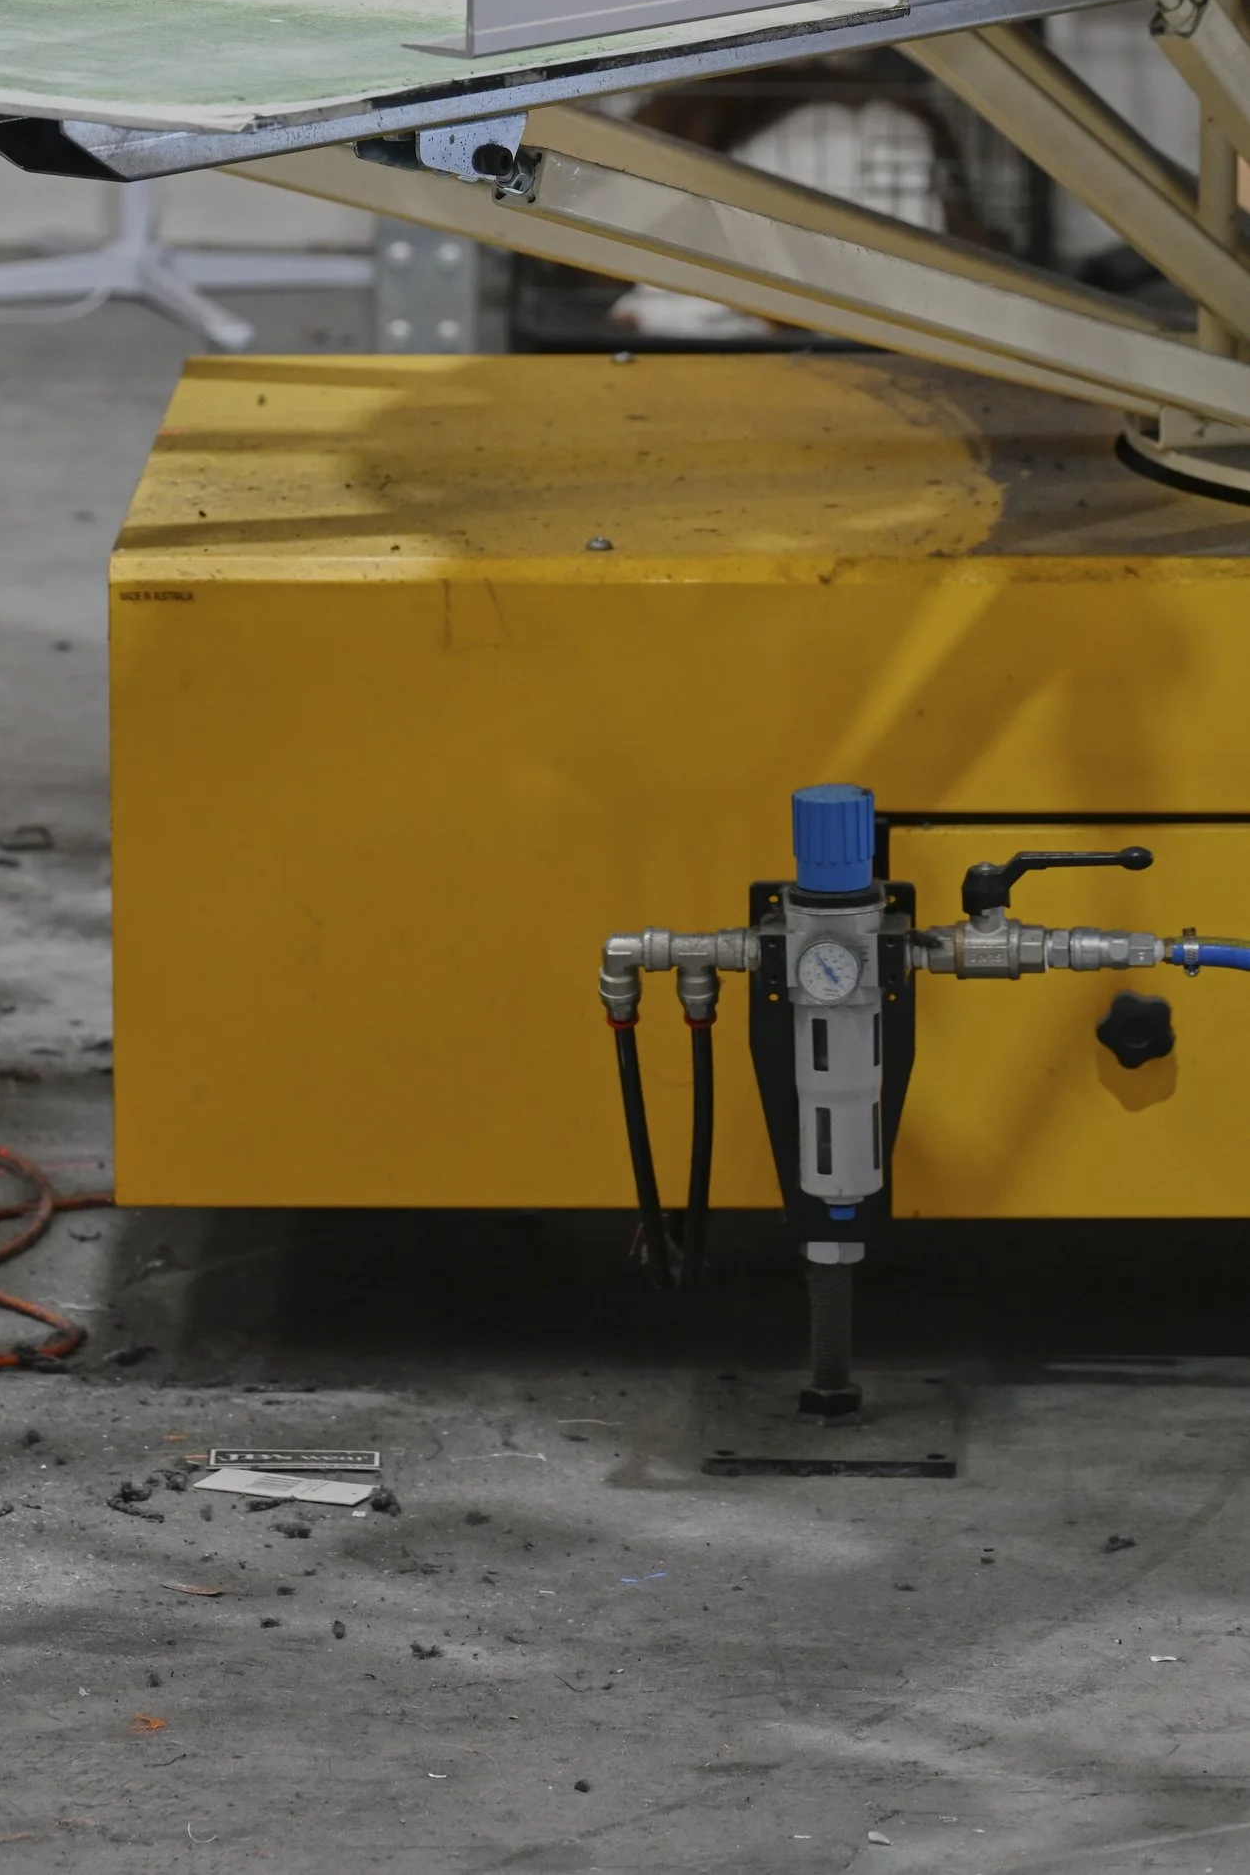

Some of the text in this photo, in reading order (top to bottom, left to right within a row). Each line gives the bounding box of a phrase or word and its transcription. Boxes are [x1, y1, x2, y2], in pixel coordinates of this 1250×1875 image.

[119, 591, 194, 602] MADE IN AUSTRALIA
